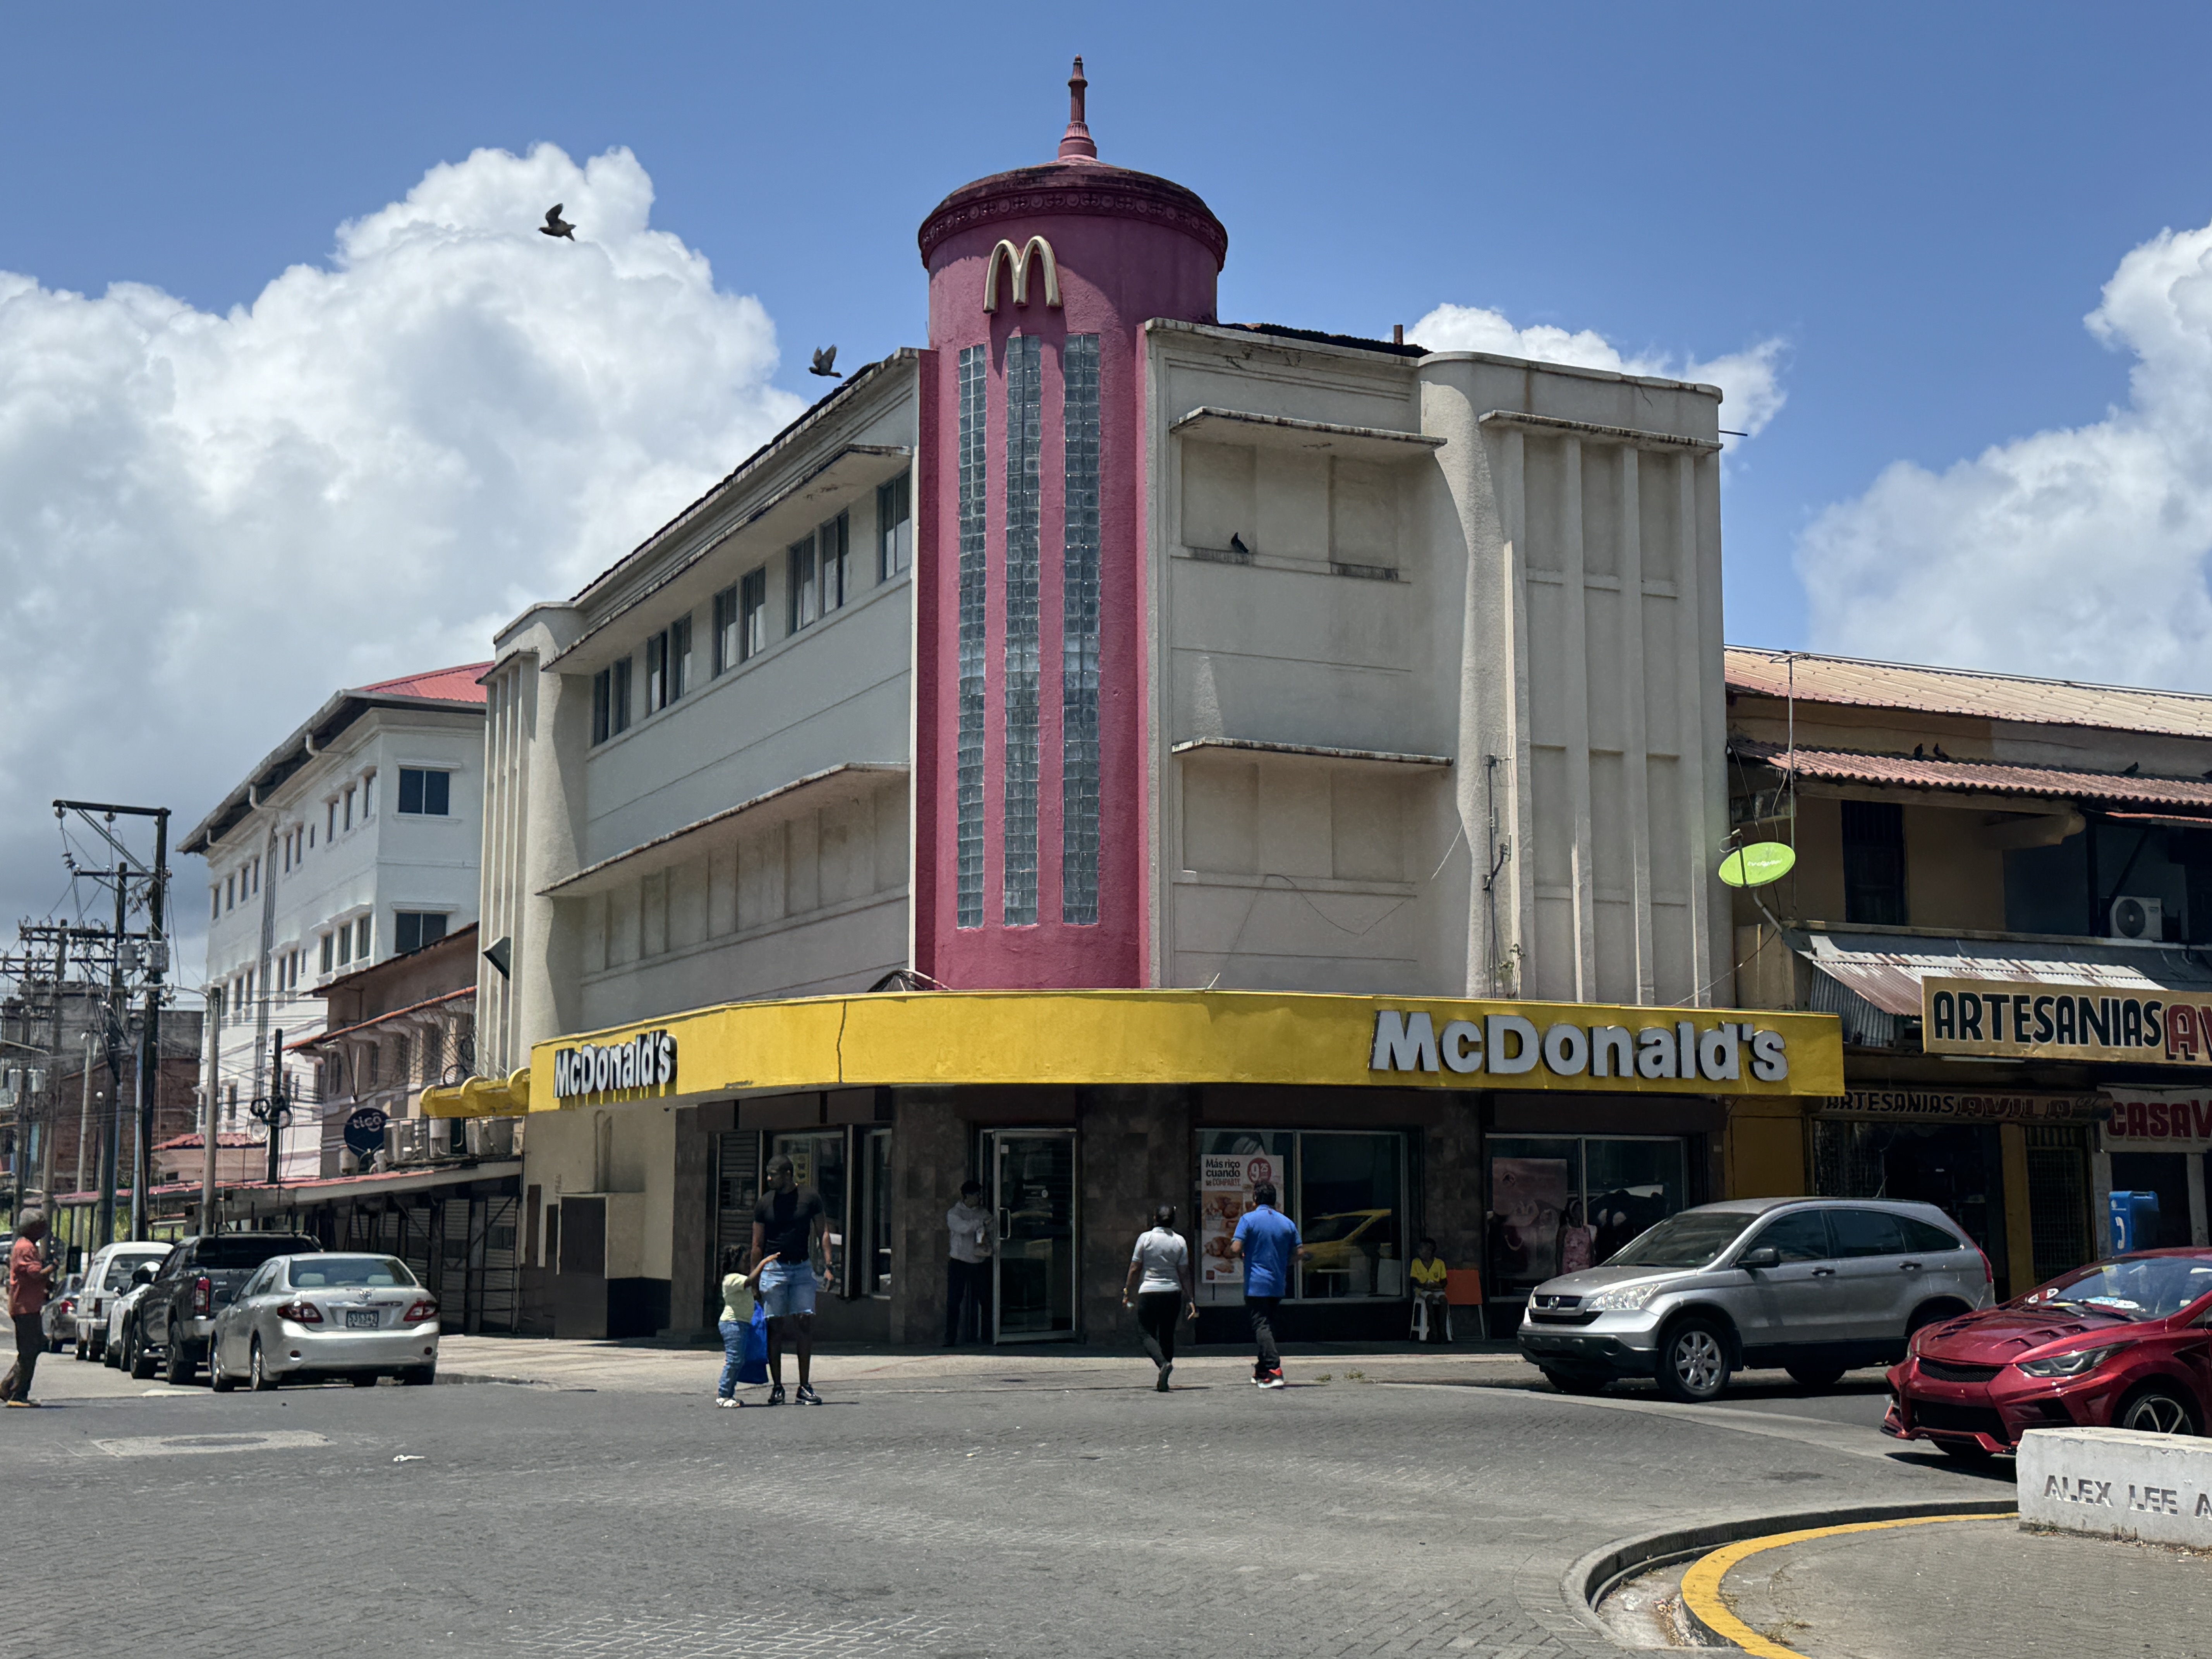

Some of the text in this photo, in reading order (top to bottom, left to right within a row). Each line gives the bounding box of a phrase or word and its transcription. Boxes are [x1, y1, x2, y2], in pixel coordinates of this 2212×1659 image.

[1368, 1009, 1788, 1081] McDonald's
[1933, 991, 2212, 1060] ARTESANIAS A
[553, 1029, 677, 1098] McDonald's
[1826, 1091, 1954, 1113] ARTESANIAS
[1958, 1096, 2071, 1118] AVILA
[1206, 1158, 1240, 1168] Más rico
[1206, 1167, 1240, 1177] cuando
[2044, 1475, 2113, 1508] ALEX
[2128, 1484, 2178, 1516] LEE
